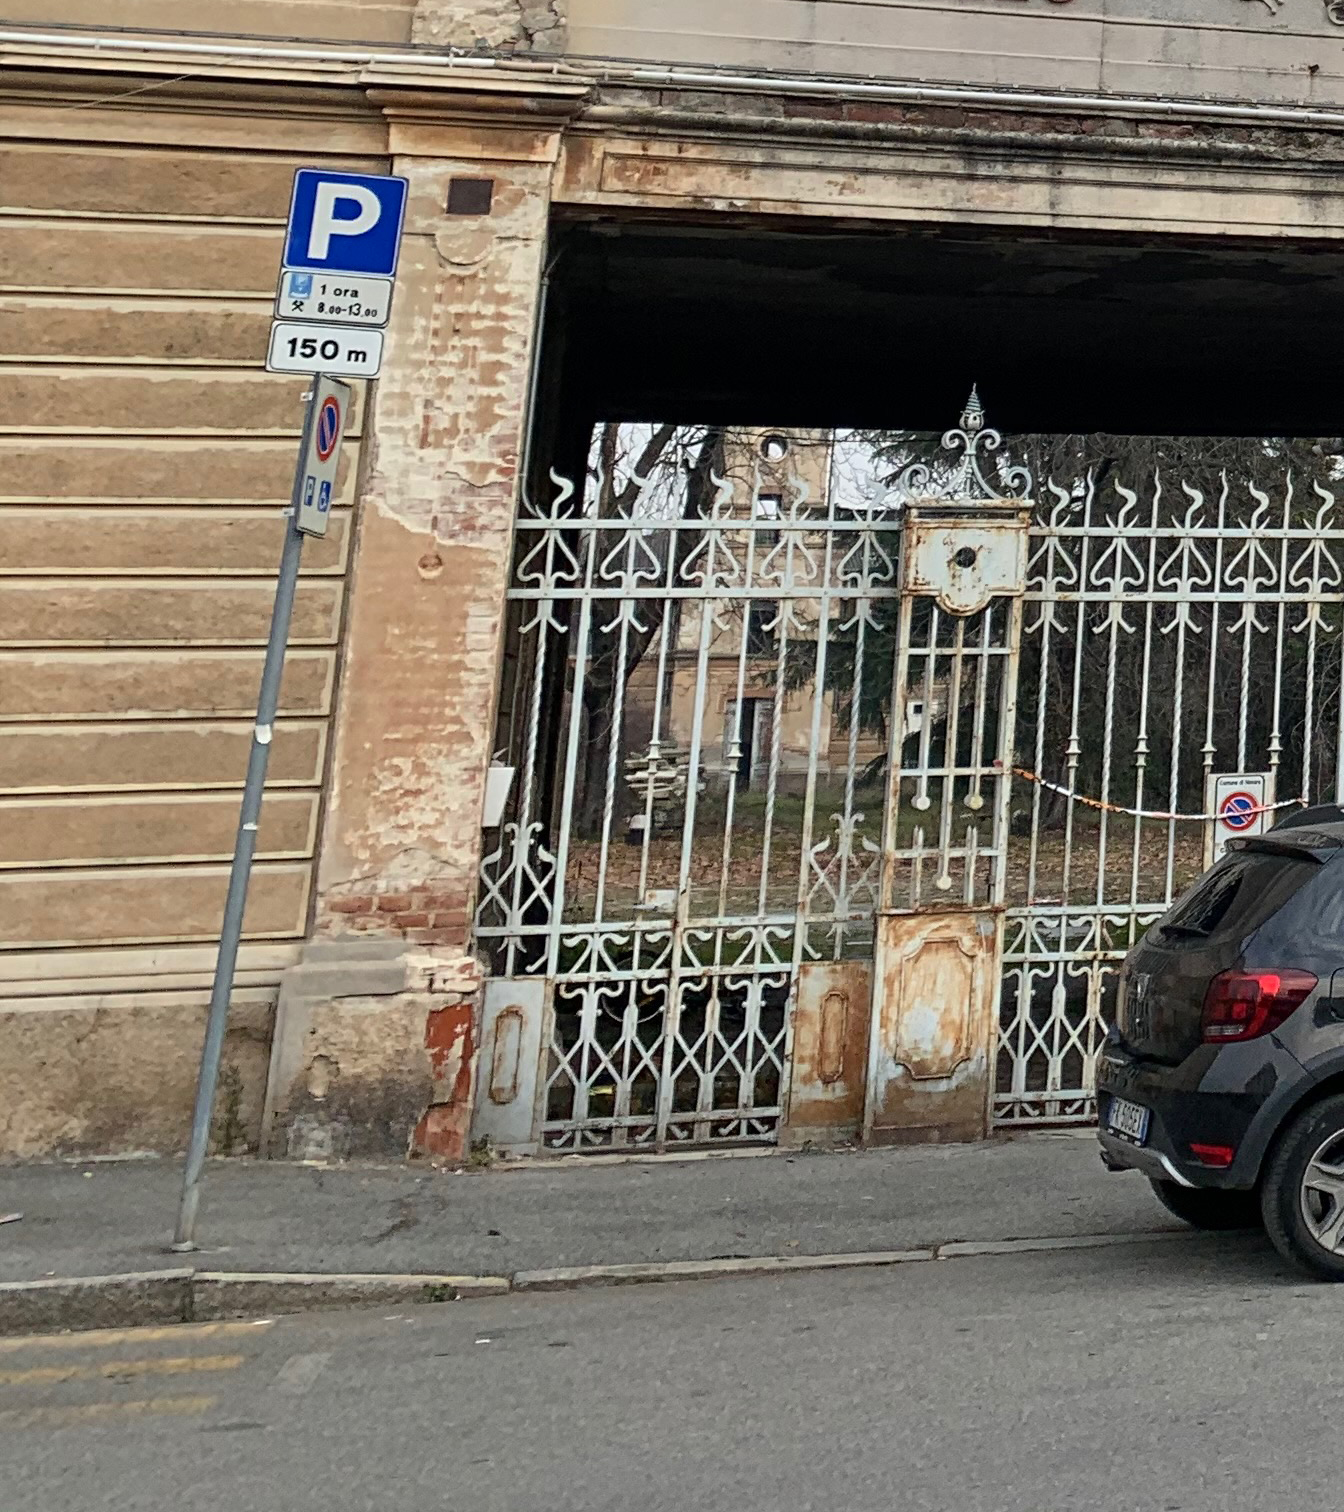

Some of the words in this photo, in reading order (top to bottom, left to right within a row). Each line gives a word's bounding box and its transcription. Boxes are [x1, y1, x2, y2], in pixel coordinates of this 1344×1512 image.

[307, 181, 382, 261] P
[320, 284, 327, 296] 1
[333, 287, 359, 298] ora
[287, 337, 340, 361] 150
[346, 349, 367, 363] m
